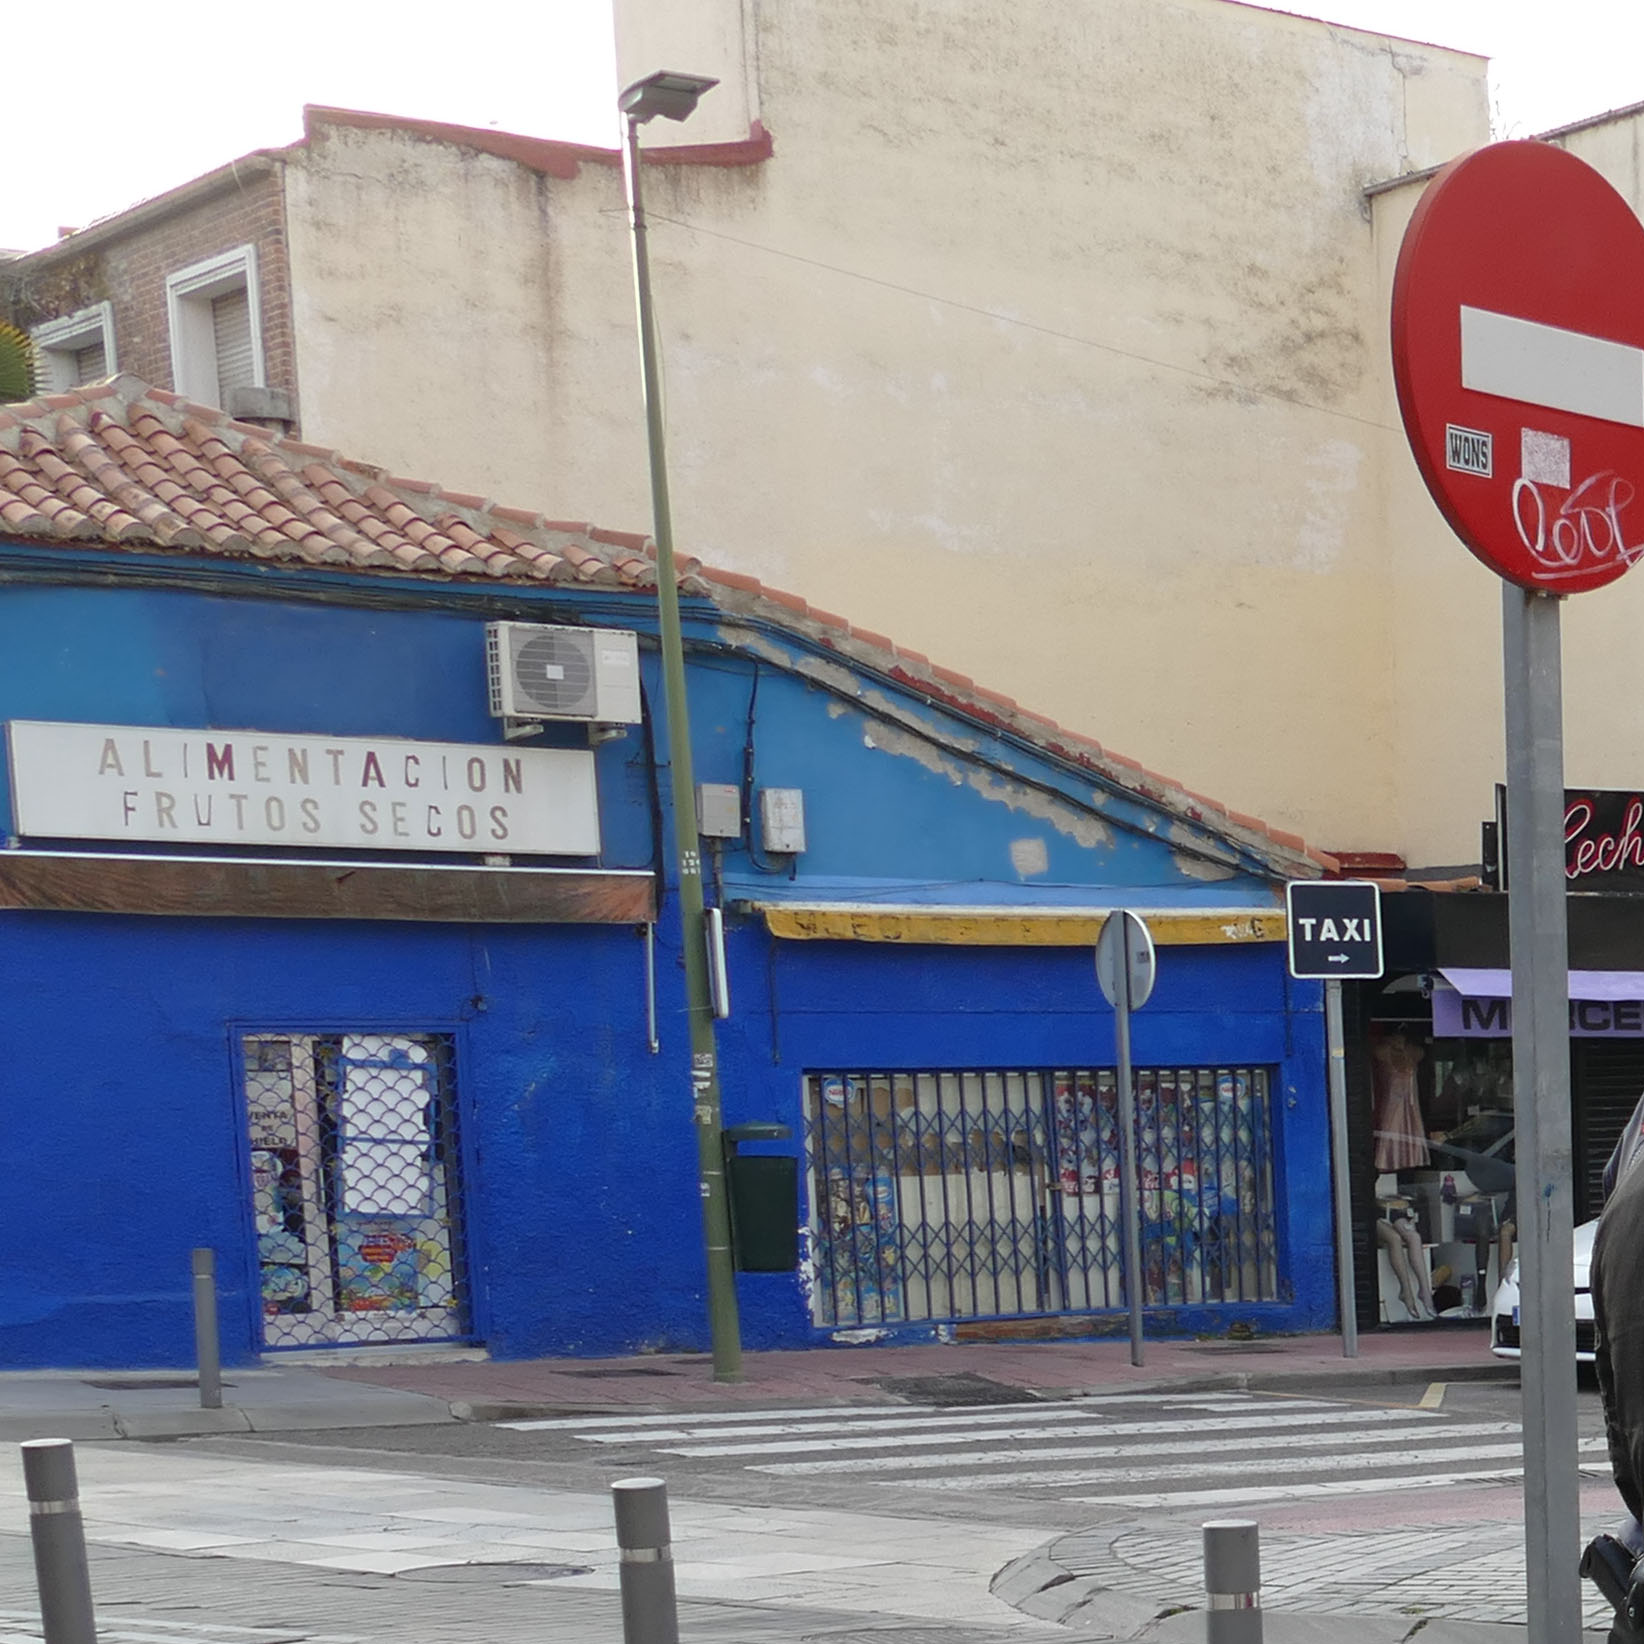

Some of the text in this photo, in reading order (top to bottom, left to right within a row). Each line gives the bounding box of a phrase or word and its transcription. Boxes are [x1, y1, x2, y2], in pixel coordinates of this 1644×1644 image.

[1449, 431, 1490, 473] WONS
[98, 738, 523, 796] ALIMENTACION
[122, 790, 510, 840] FRUTOS SECOS
[1299, 917, 1372, 943] TAXI
